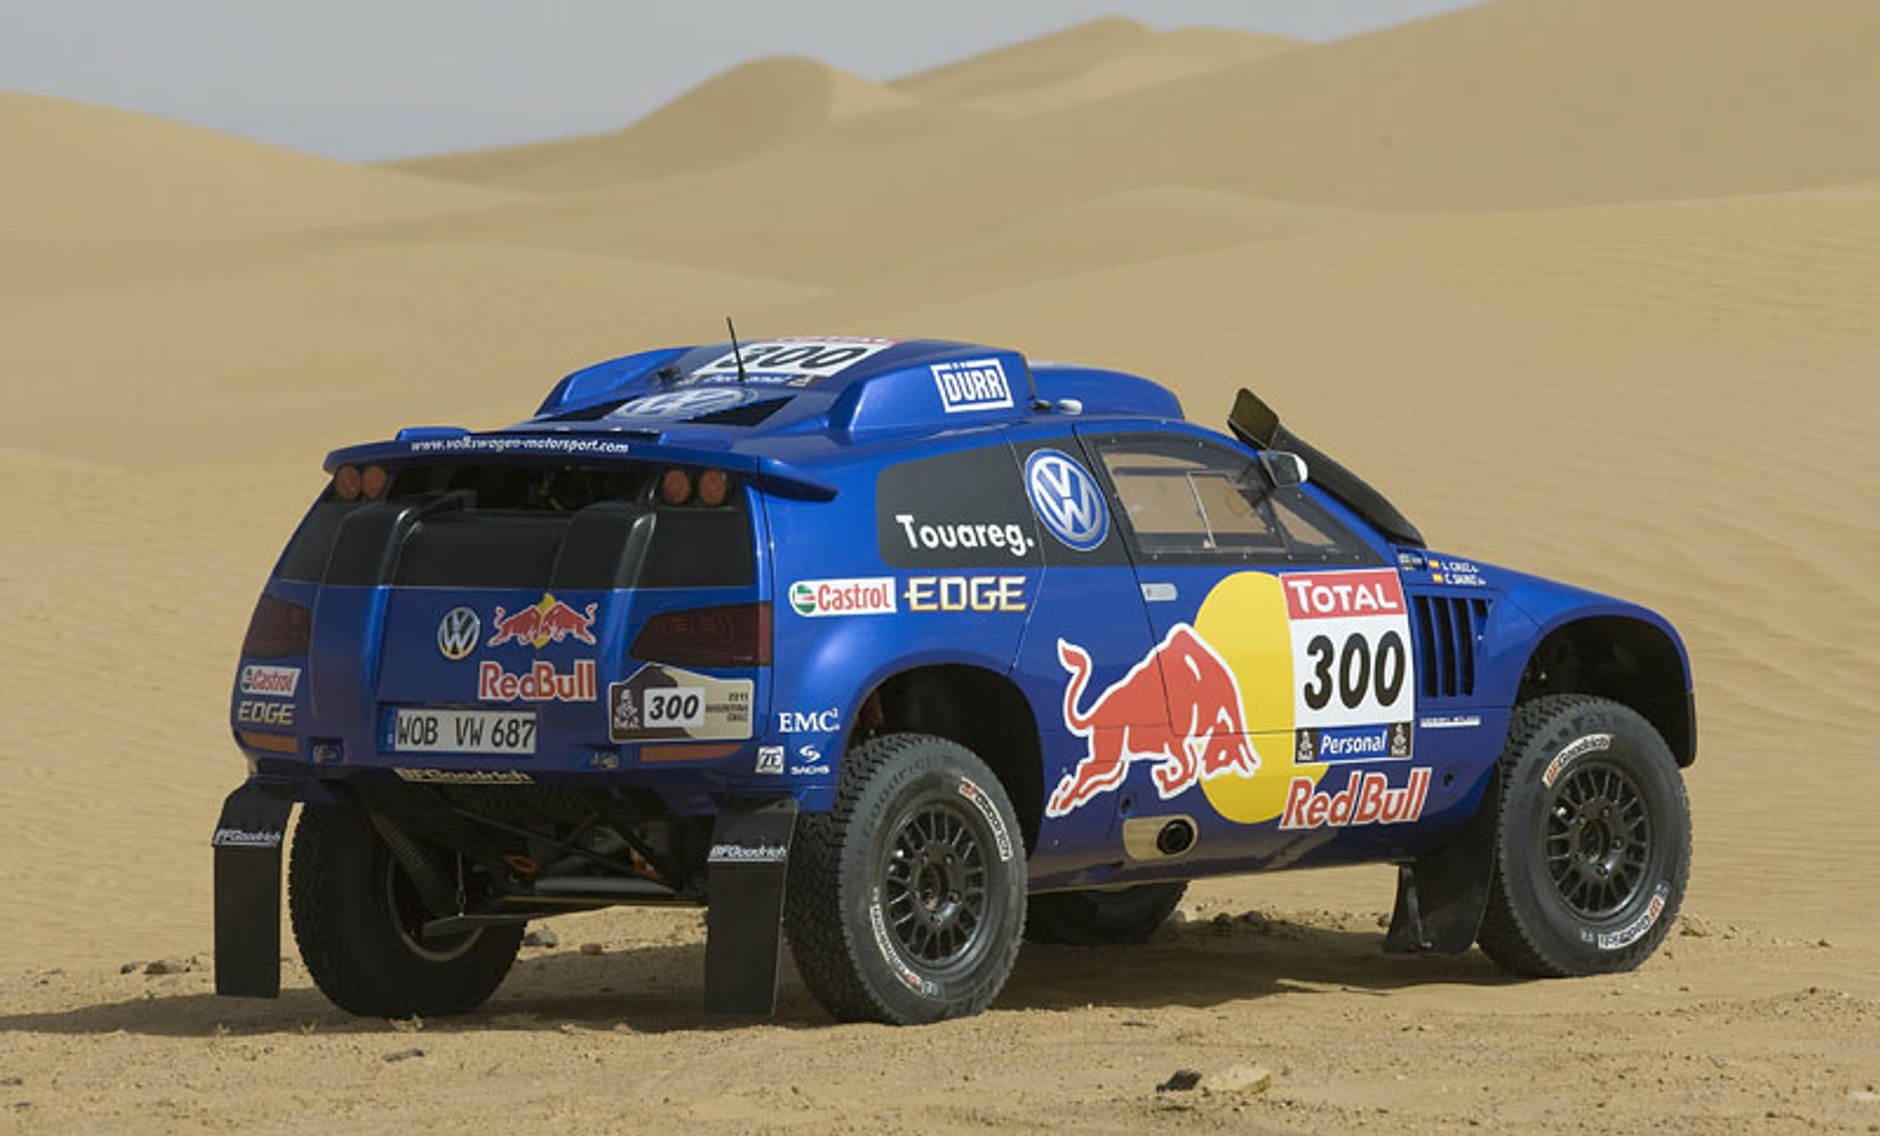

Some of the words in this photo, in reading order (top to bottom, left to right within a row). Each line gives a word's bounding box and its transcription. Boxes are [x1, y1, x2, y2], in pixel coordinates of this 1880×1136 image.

[715, 345, 868, 369] 300
[817, 583, 892, 611] Castrol
[903, 576, 1028, 611] EDGE
[251, 668, 296, 693] Castrol
[1304, 630, 1407, 711] 300
[238, 701, 296, 725] EDGE
[649, 694, 700, 721] 300
[398, 716, 439, 746] WOB
[454, 717, 486, 748] VW
[491, 718, 536, 749] 687
[1320, 729, 1388, 755] Personal
